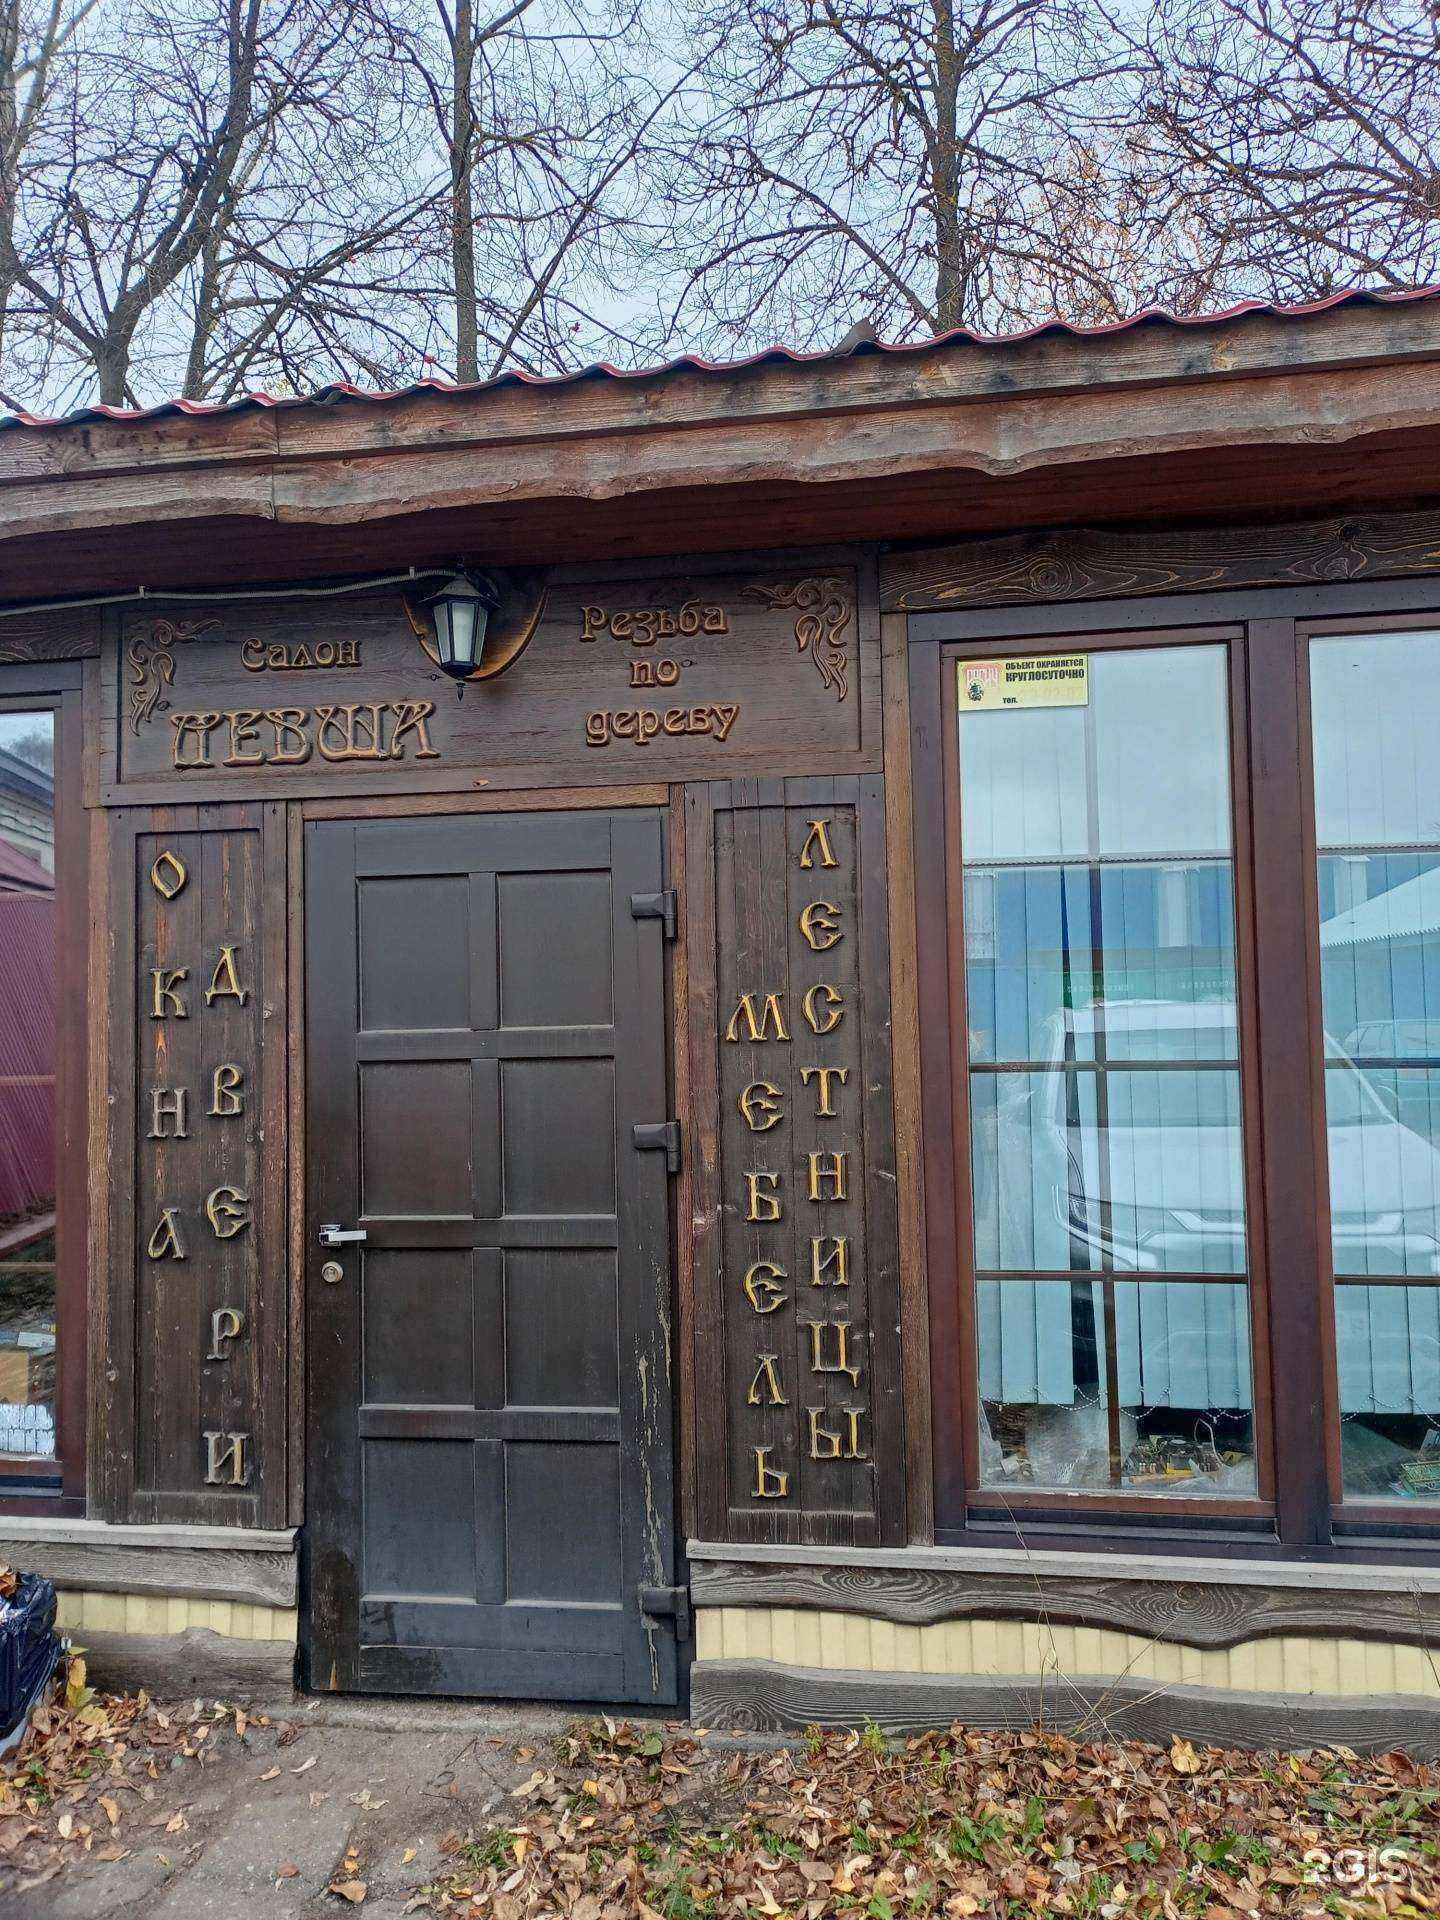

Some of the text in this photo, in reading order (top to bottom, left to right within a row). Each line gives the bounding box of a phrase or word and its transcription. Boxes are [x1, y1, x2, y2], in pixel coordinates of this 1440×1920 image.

[580, 599, 728, 646] Резьба
[241, 635, 362, 672] Салон
[1005, 658, 1084, 670] ОБЪЕКТ ОХРАНЯЕТСЯ
[629, 658, 681, 688] по
[1005, 668, 1085, 682] КРУГЛОСУТОЧНО
[170, 700, 441, 769] ЛЕВША
[586, 704, 740, 747] дереву
